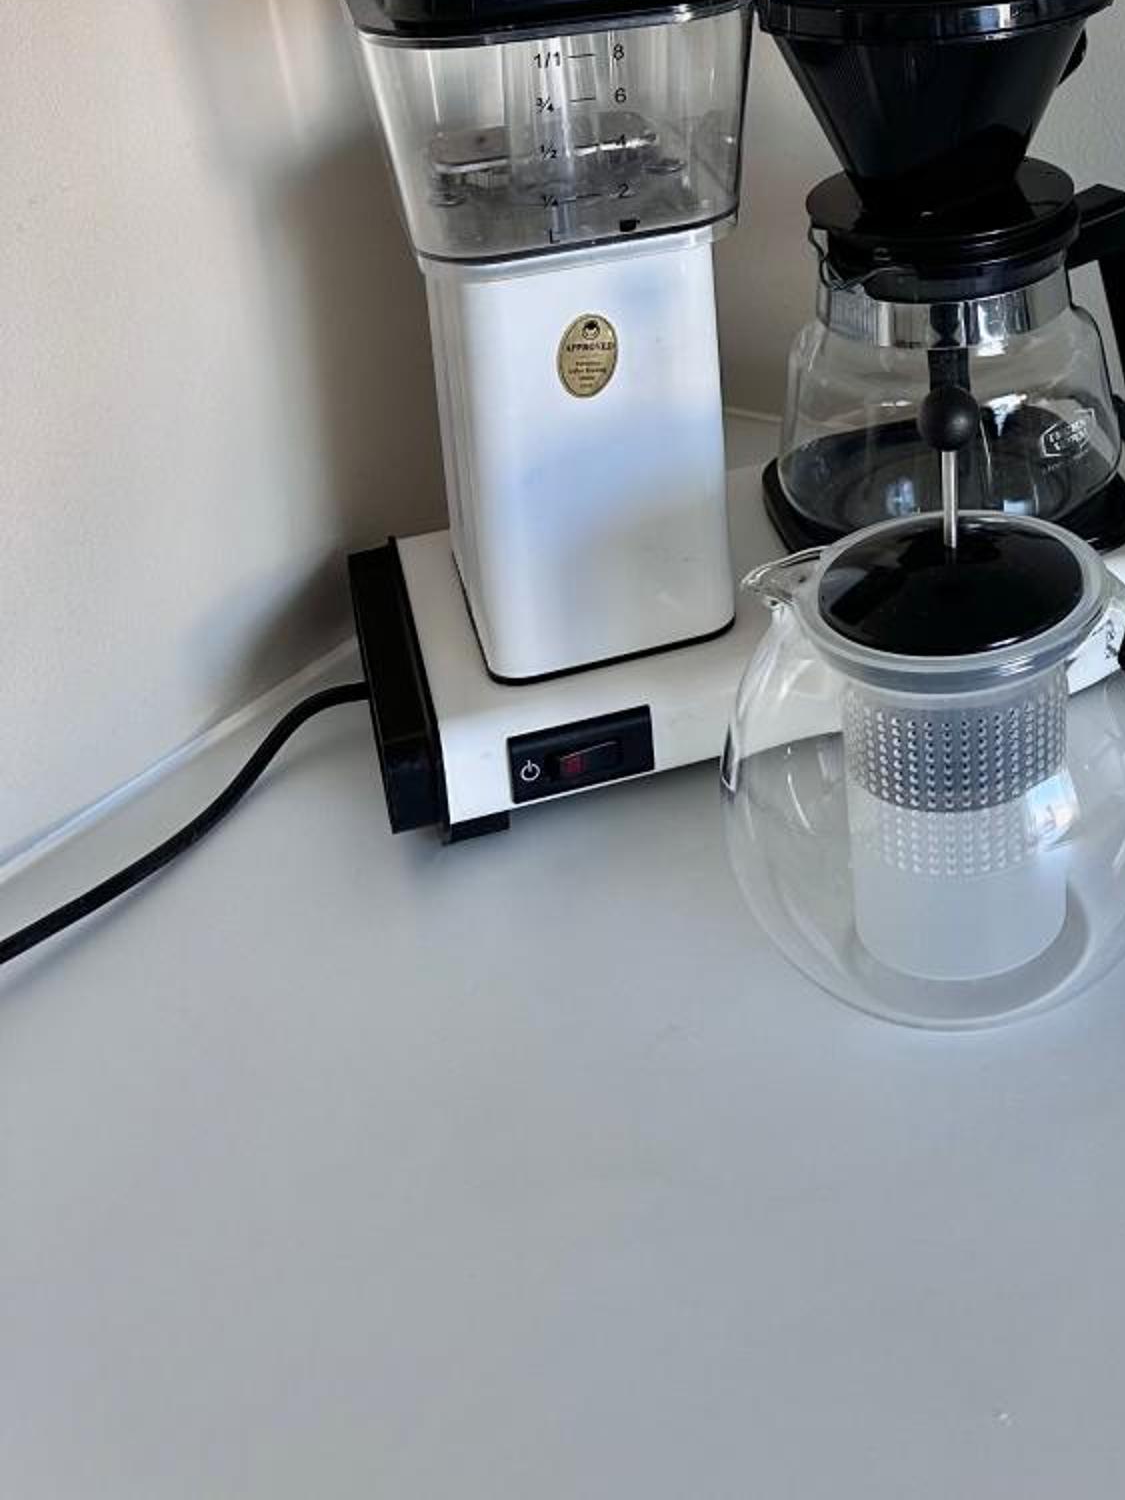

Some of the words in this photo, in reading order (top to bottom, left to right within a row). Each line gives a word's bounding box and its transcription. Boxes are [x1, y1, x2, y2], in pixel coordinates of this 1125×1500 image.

[533, 51, 561, 69] 1/1
[613, 43, 625, 61] 8
[614, 87, 627, 104] 6
[618, 182, 633, 199] 2
